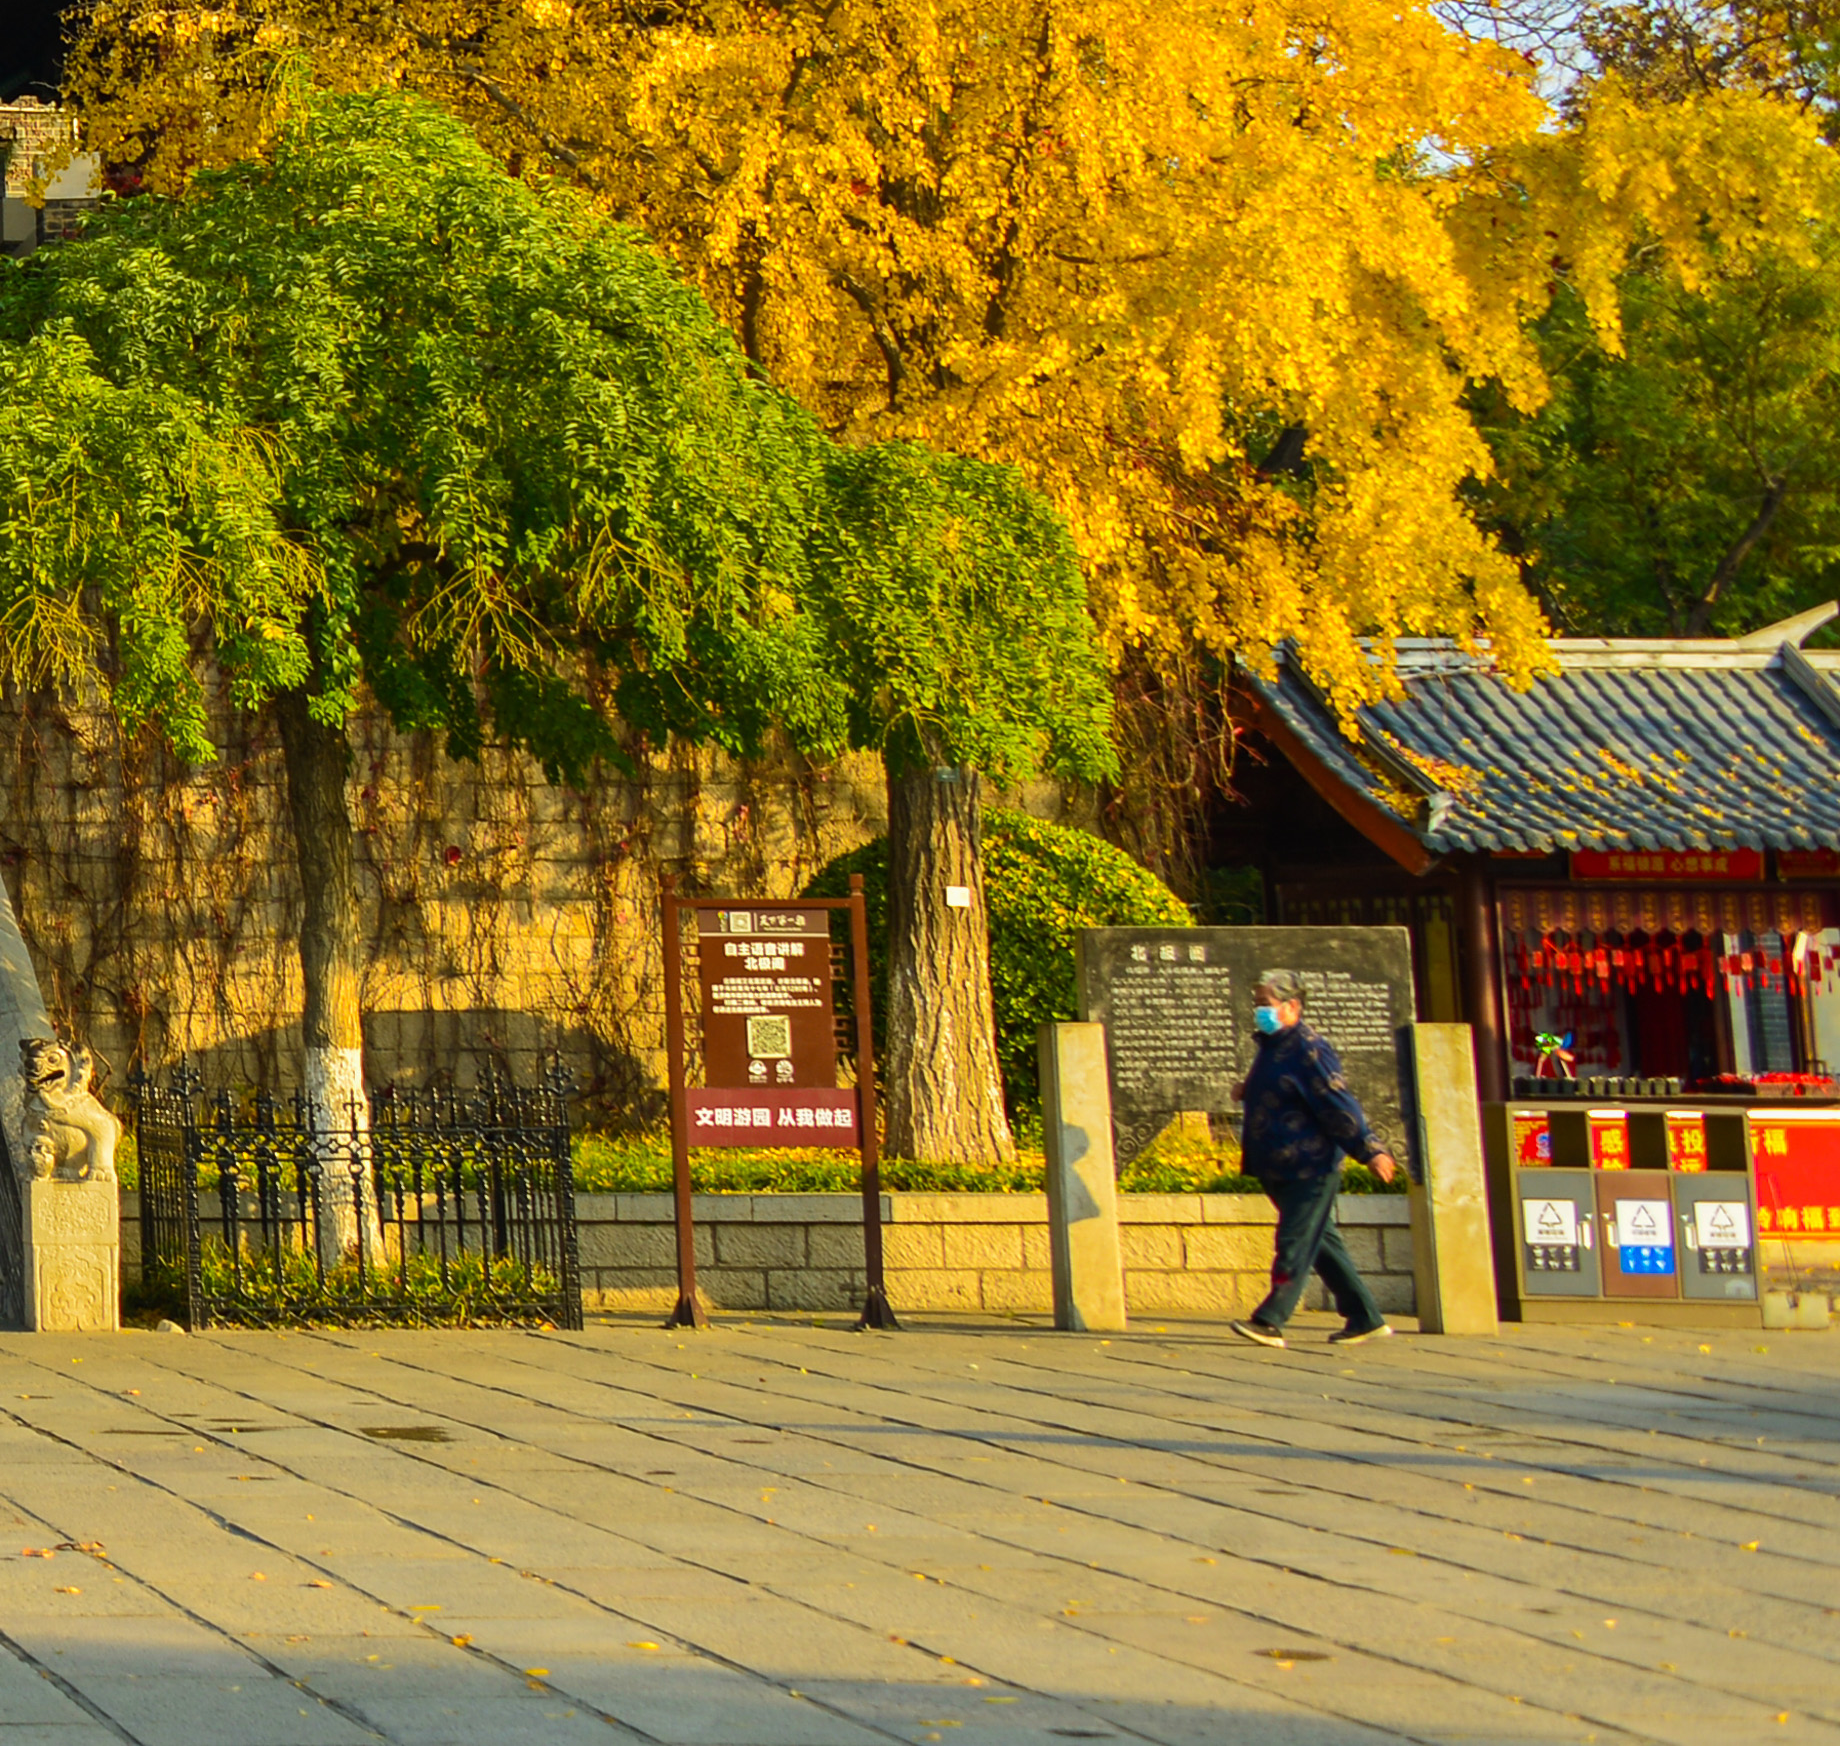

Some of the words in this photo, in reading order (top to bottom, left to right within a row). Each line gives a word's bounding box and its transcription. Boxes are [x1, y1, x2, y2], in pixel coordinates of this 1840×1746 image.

[1670, 855, 1730, 874] 心想事成
[723, 941, 805, 957] 自主语音讲解
[743, 956, 787, 971] 北极阁
[695, 1107, 772, 1127] 文明游园
[777, 1107, 853, 1128] 从我做起
